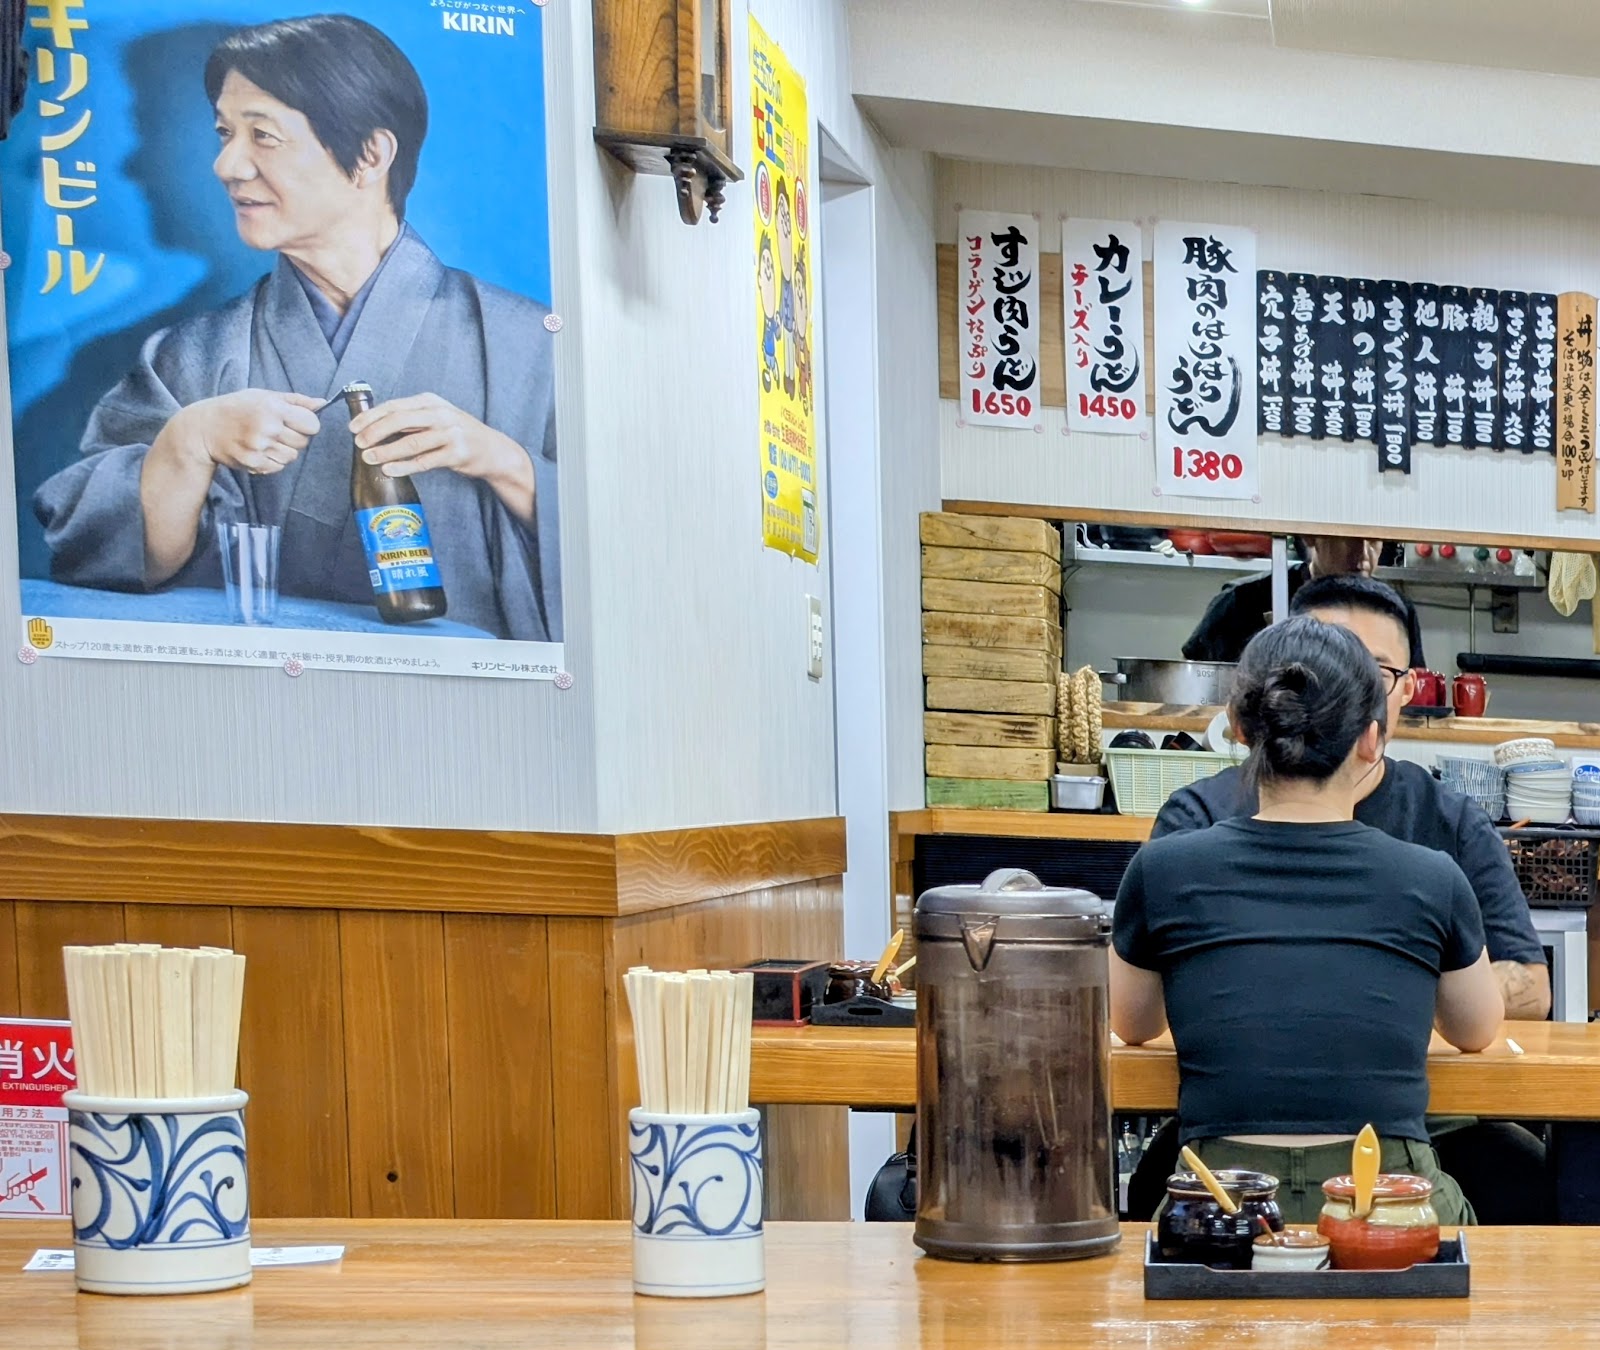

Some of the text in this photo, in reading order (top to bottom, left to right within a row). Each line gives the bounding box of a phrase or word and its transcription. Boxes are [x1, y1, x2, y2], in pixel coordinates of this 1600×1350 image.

[443, 11, 515, 36] KIRIN
[30, 0, 105, 295] キリンビール
[965, 235, 988, 380] コラーゲンたっぷり
[990, 225, 1037, 392] すじ肉うどん
[1070, 264, 1091, 368] チーズ入り
[1090, 233, 1141, 394] カレーうどん
[1259, 285, 1285, 393] 穴子丼
[1291, 287, 1315, 395] 唐あげ丼
[1320, 292, 1346, 400] 天丼
[1352, 296, 1376, 403] かつ丼
[1382, 296, 1410, 418] まぐろ丼
[1414, 299, 1440, 411] 他人丼
[1441, 303, 1469, 411] 豚丼
[1469, 299, 1498, 412] 親子丼
[1503, 308, 1527, 411] きざみ丼
[1531, 306, 1556, 410] 玉子丼
[379, 549, 429, 561] KIRIN BEER
[391, 566, 429, 580] 晴れ風
[471, 661, 558, 675] キリンビール株式会社
[2, 1081, 69, 1092] EXTINGUISHER
